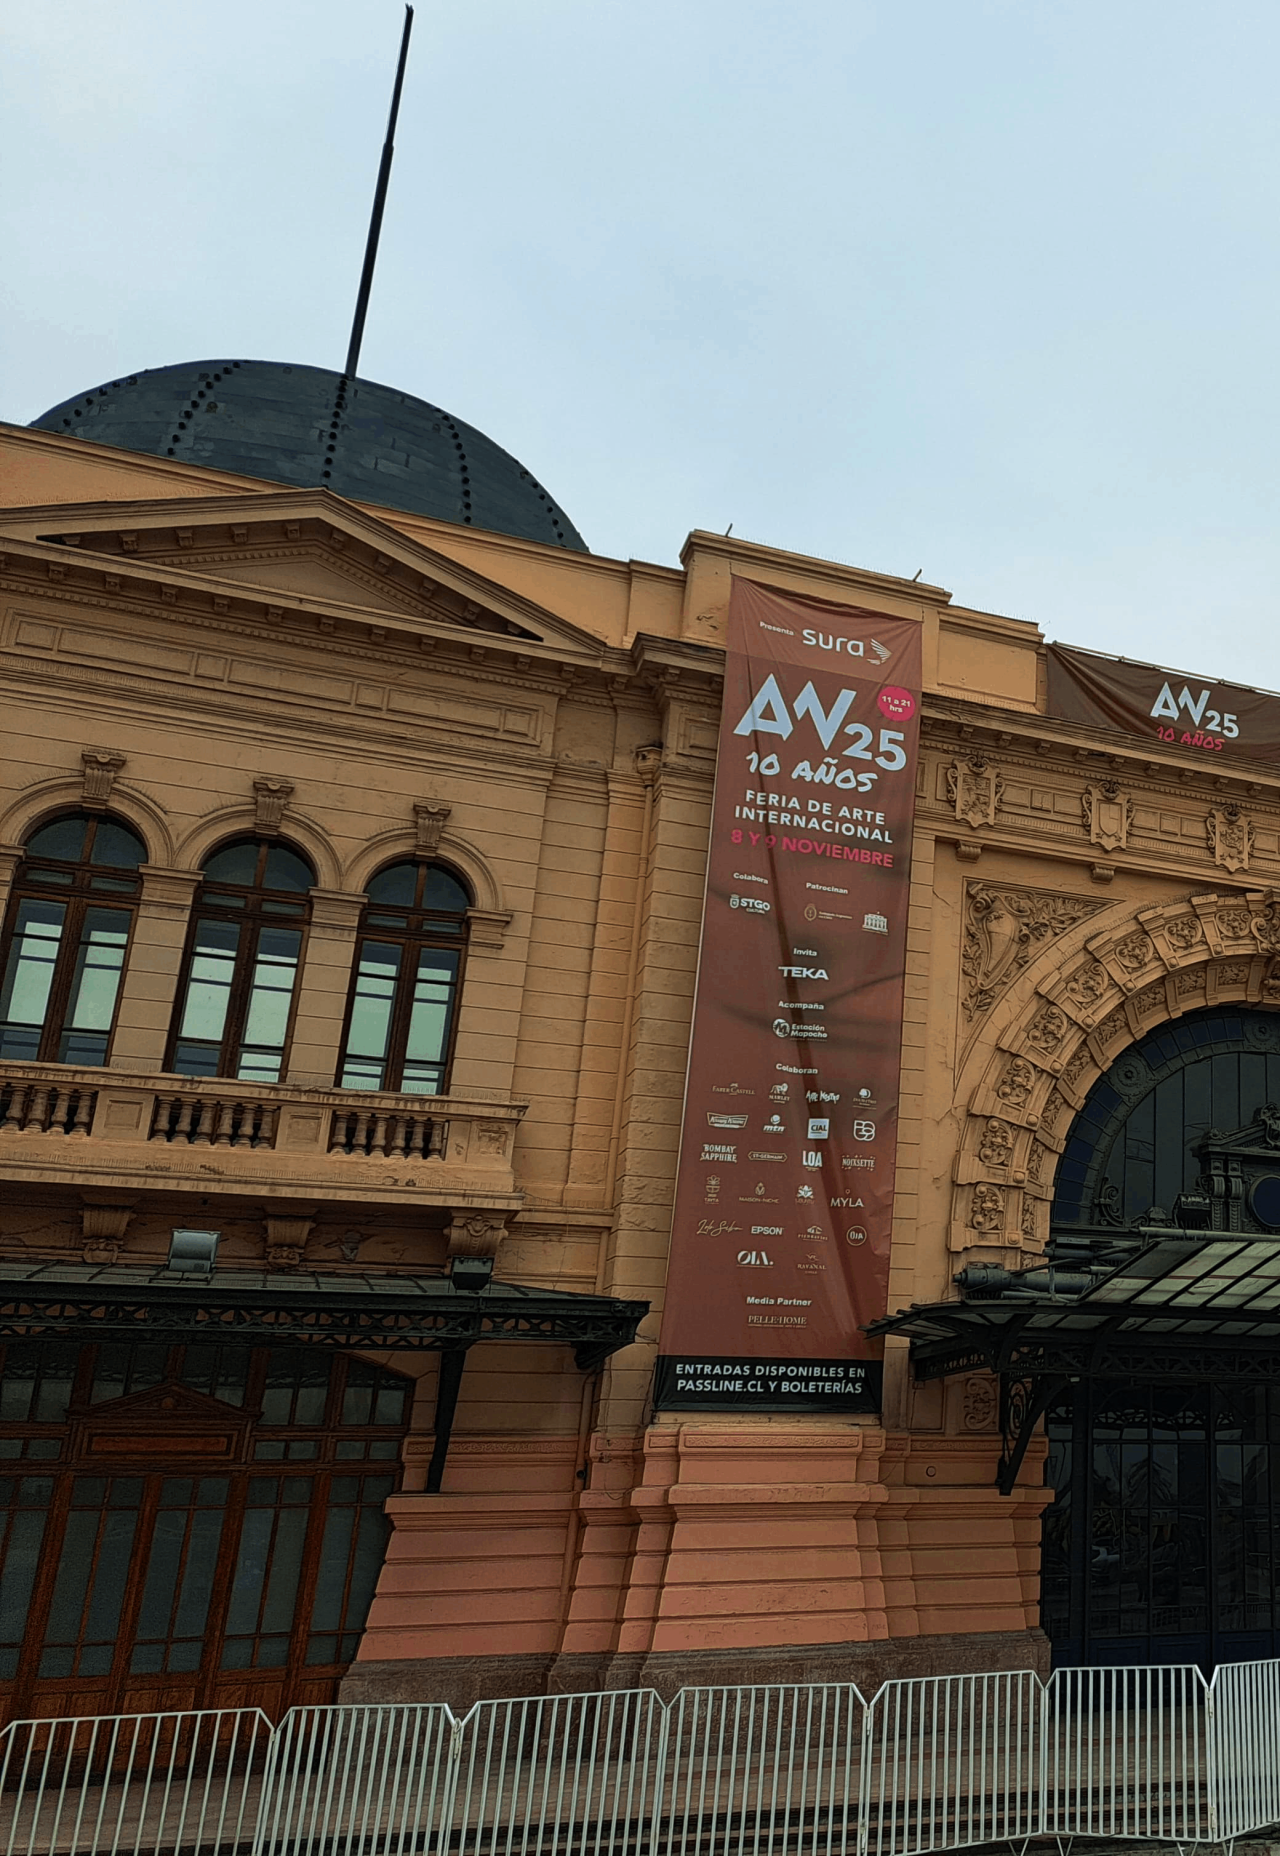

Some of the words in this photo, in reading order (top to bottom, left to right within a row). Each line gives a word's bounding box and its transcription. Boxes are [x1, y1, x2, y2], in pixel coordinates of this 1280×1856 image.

[760, 621, 794, 636] Presenta
[803, 629, 864, 657] sura
[889, 704, 903, 713] hrs
[901, 699, 911, 708] 21
[1157, 726, 1175, 741] 10
[1180, 730, 1226, 750] AÑOS
[746, 752, 780, 775] 10
[791, 757, 878, 792] AÑOS
[746, 789, 801, 809] FERIA
[807, 799, 833, 815] DE
[838, 806, 886, 825] ARTE
[735, 805, 893, 844] INTERNACIONAL
[731, 829, 743, 844] 8
[749, 831, 761, 846] Y
[765, 834, 777, 848] 9
[782, 837, 894, 867] NOVIEMBRE
[733, 872, 768, 884] Colabora
[806, 882, 848, 894] Patrocinan
[740, 898, 771, 911] STGO
[793, 948, 817, 957] Invita
[778, 966, 829, 980] TEKA
[778, 1000, 824, 1010] Acompaña
[791, 1023, 825, 1031] Estación
[790, 1030, 828, 1038] Mapocho
[775, 1063, 818, 1075] Colaboran
[811, 1124, 827, 1132] CIAL
[703, 1144, 737, 1153] BOMBAY
[700, 1152, 738, 1163] SAPPHIRE
[802, 1150, 822, 1167] LOA
[830, 1197, 865, 1207] MYLA
[751, 1226, 783, 1235] EPSON
[746, 1296, 775, 1304] Media
[777, 1297, 812, 1306] Partner
[676, 1364, 750, 1376] ENTRADAS
[755, 1365, 844, 1377] DISPONIBLES
[849, 1367, 865, 1378] EN
[677, 1380, 764, 1392] PASSLINE.CL
[769, 1381, 777, 1392] Y
[781, 1379, 862, 1394] BOLETERÍAS
